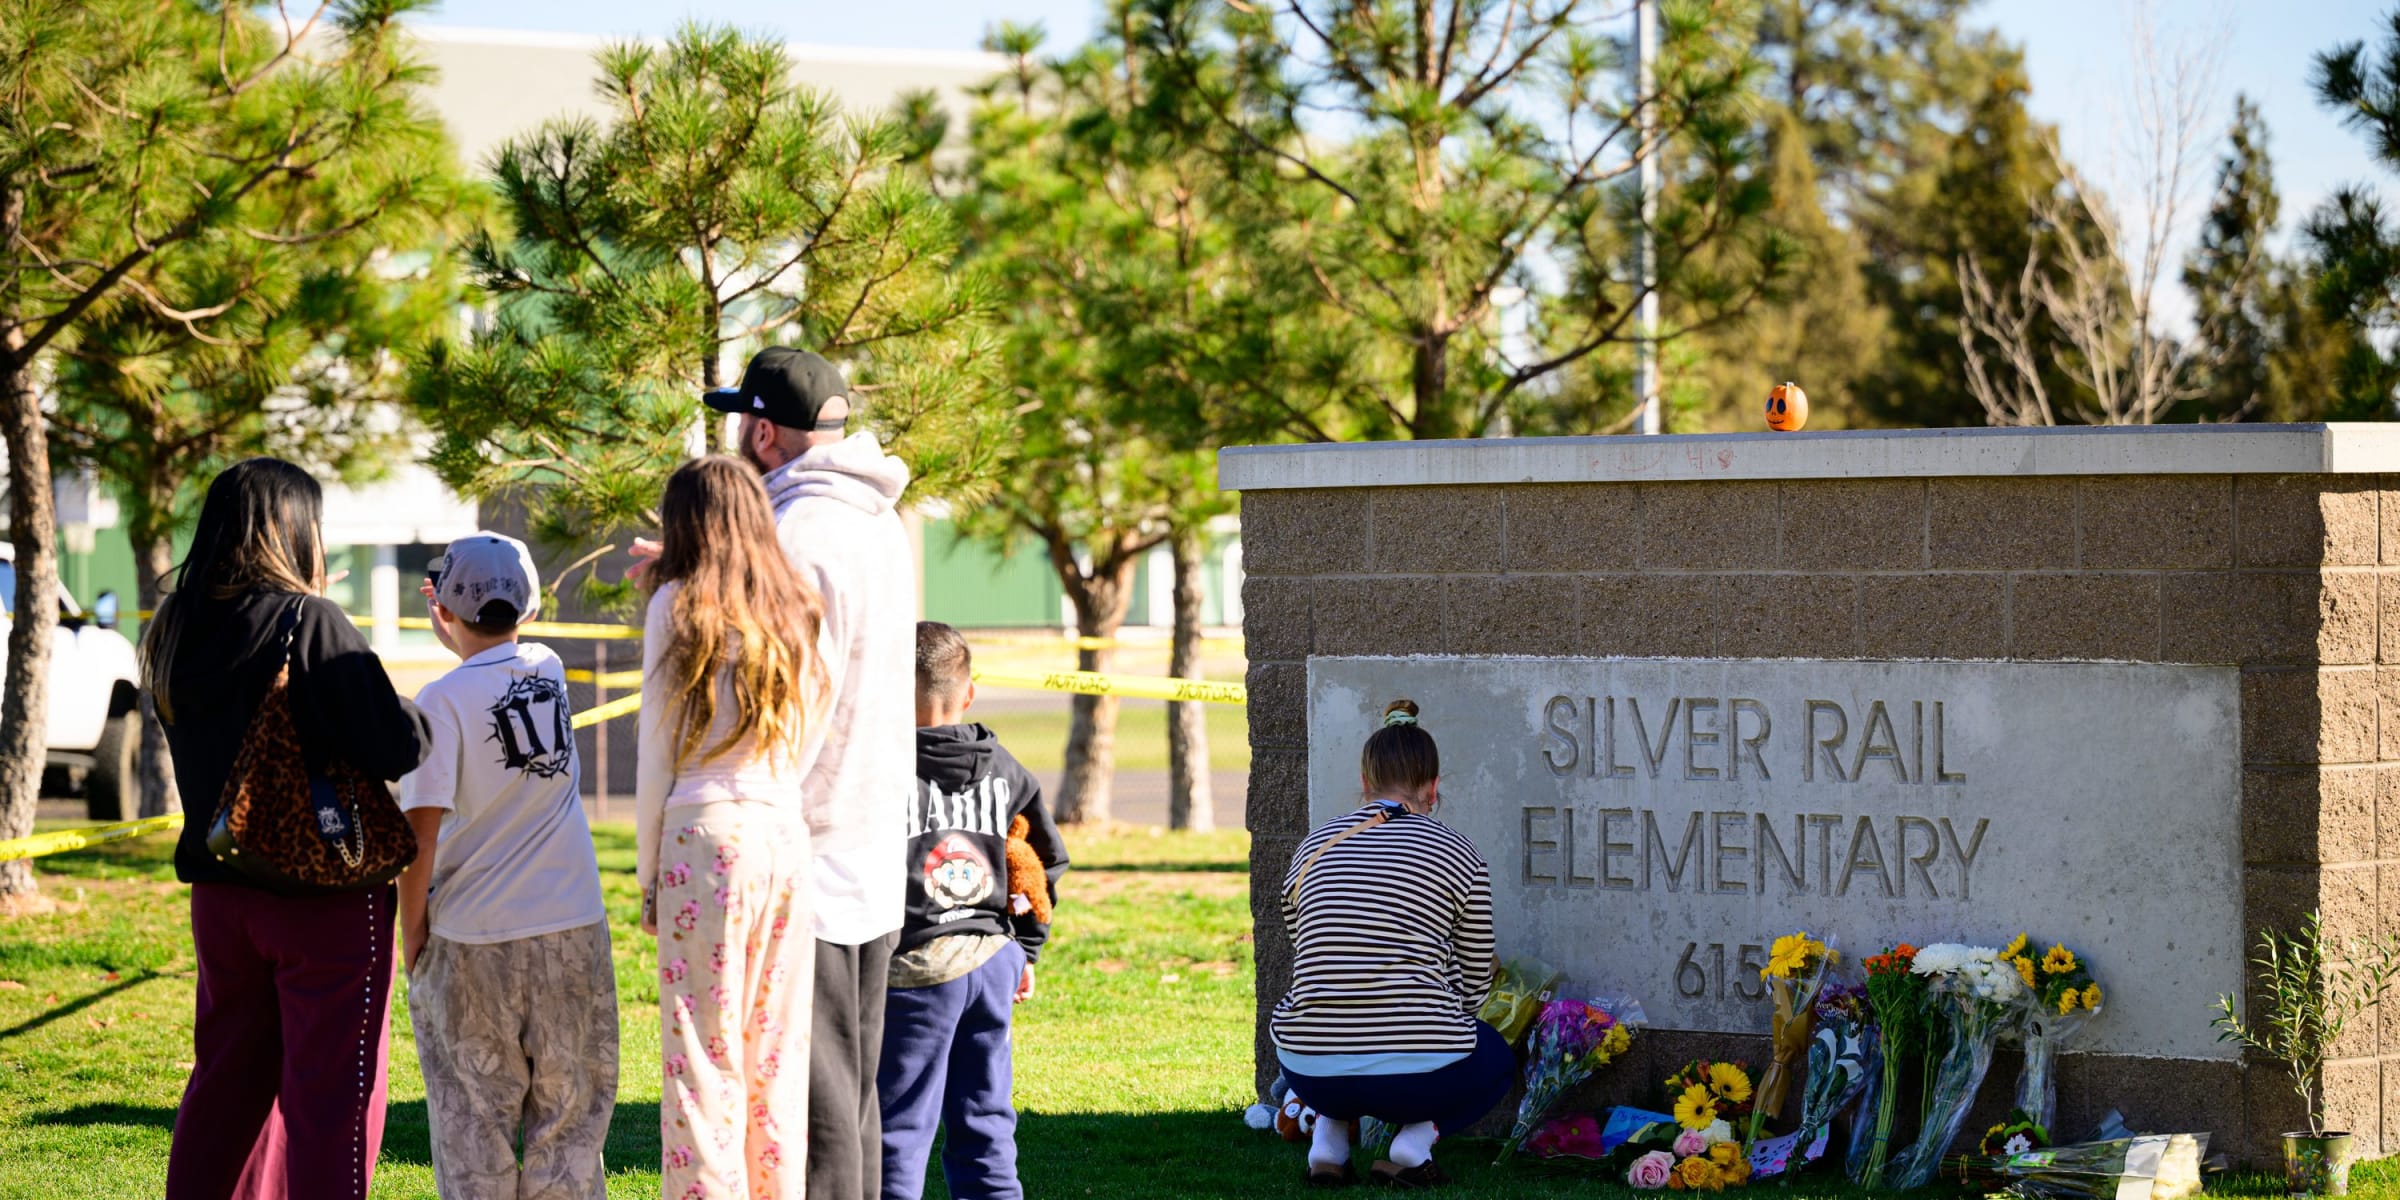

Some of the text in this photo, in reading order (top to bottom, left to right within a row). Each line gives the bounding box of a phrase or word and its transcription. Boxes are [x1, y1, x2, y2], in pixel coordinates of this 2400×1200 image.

[1542, 694, 1966, 785] SILVER RAIL
[1521, 806, 1990, 900] ELEMENTARY
